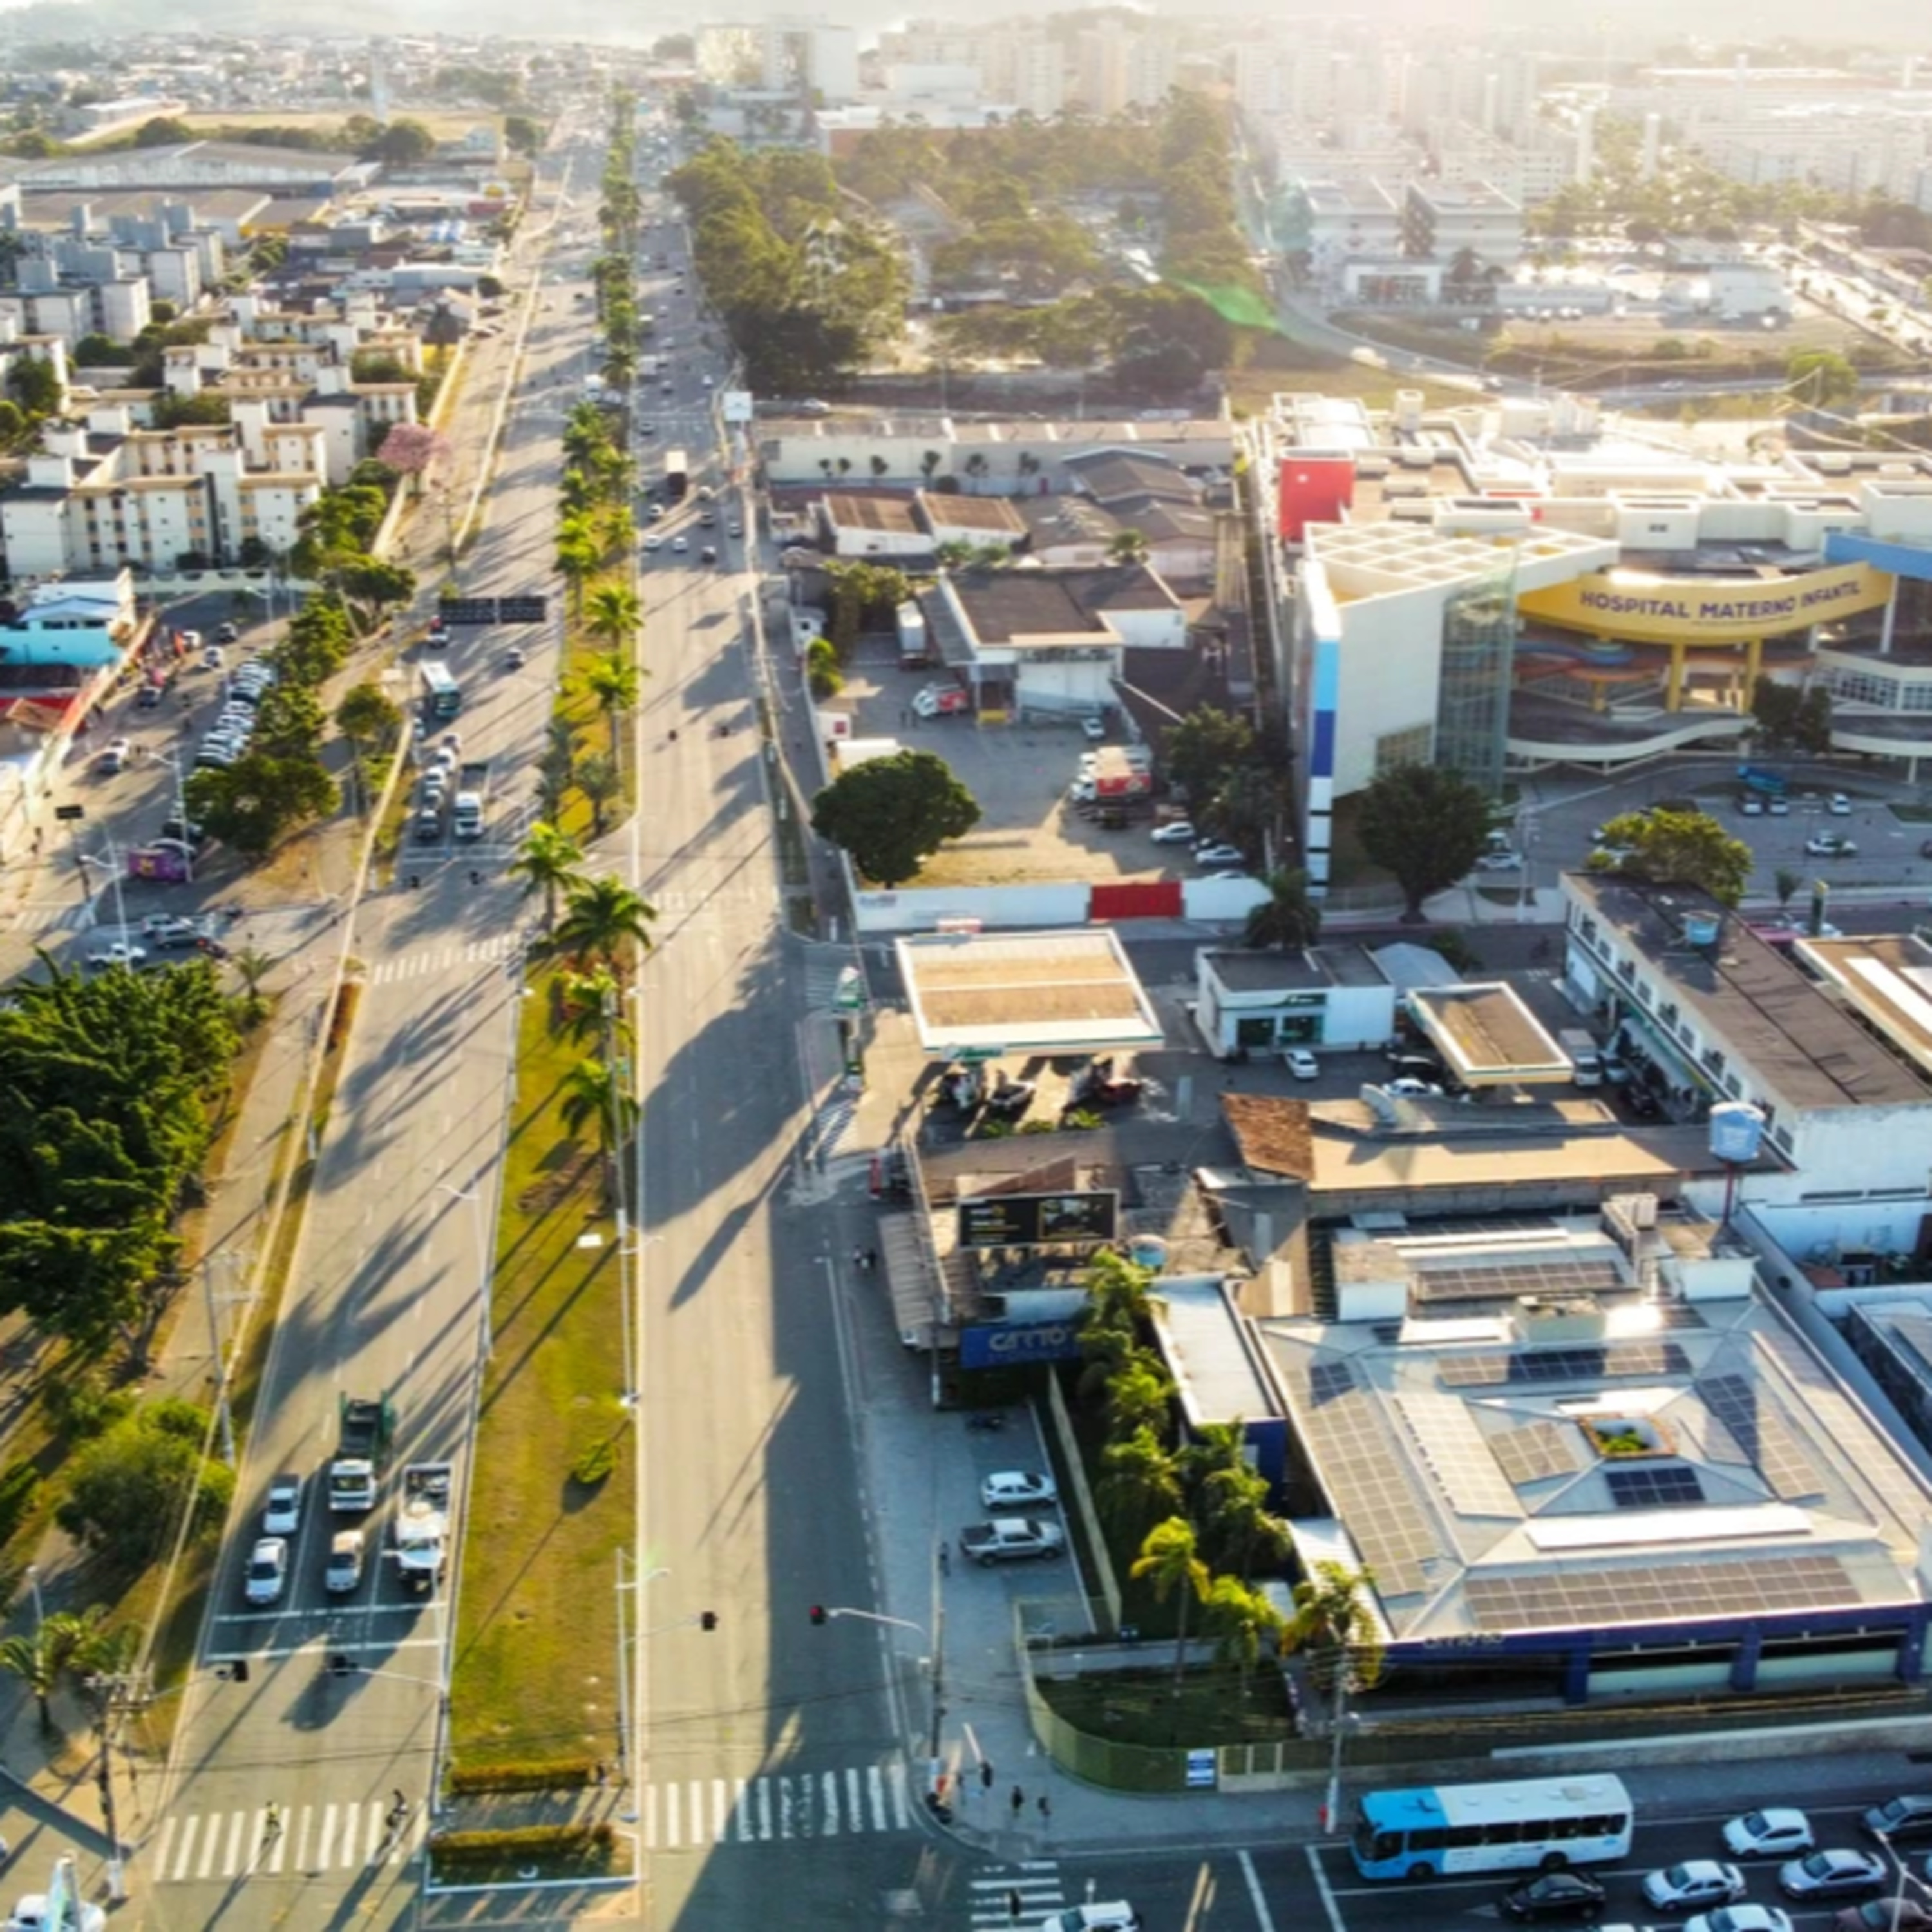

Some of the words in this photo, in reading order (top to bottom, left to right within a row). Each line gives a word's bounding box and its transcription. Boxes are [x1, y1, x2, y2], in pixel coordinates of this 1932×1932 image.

[1580, 591, 1690, 618] HOSPITAL
[1700, 596, 1795, 618] MATERNO
[1802, 581, 1860, 607] INFANTIL
